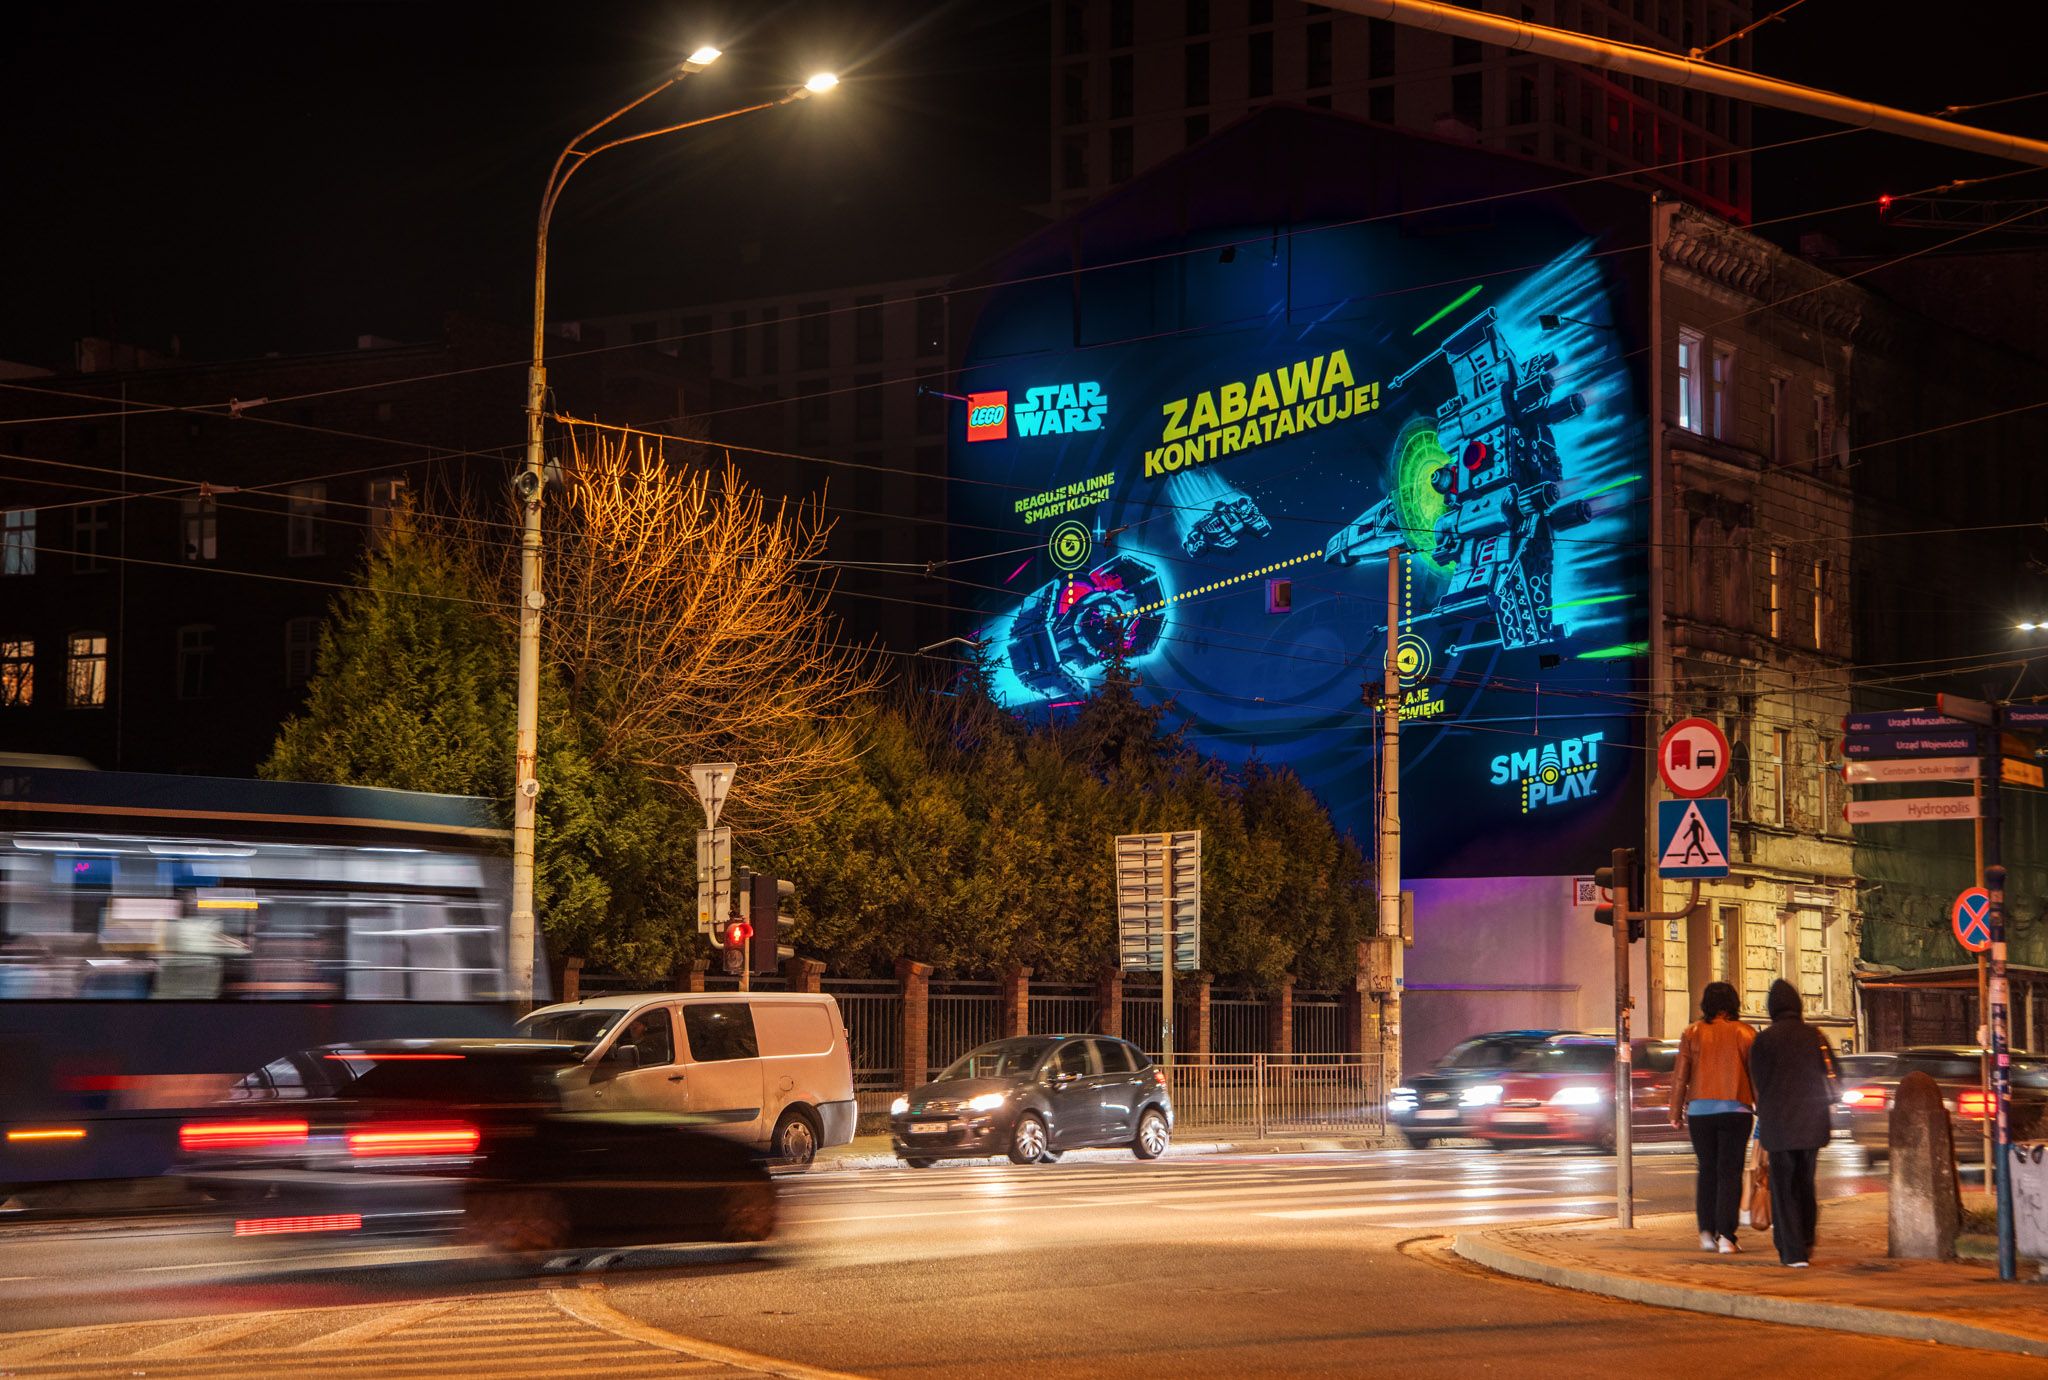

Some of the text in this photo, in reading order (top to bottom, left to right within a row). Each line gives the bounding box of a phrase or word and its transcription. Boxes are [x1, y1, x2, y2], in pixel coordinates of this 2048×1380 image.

[1014, 381, 1108, 413] STAR
[1163, 349, 1355, 443] ZABAWA
[970, 405, 1005, 427] LEGO
[1015, 405, 1108, 437] WARS
[1144, 381, 1380, 478] KONTRATAKUJE!
[1015, 472, 1115, 513] REAGUJE NA INNE
[1024, 488, 1110, 525] SMART KLOCKI
[1398, 699, 1445, 722] ŹWIĘKI
[1888, 717, 1911, 728] Urząd
[1490, 731, 1604, 785] SMART
[1896, 740, 1919, 751] Urząd
[1882, 766, 1917, 776] Centrum
[1918, 766, 1942, 776] Sztuki
[1528, 769, 1598, 809] PLAY
[1907, 801, 1971, 818] Hydropolis
